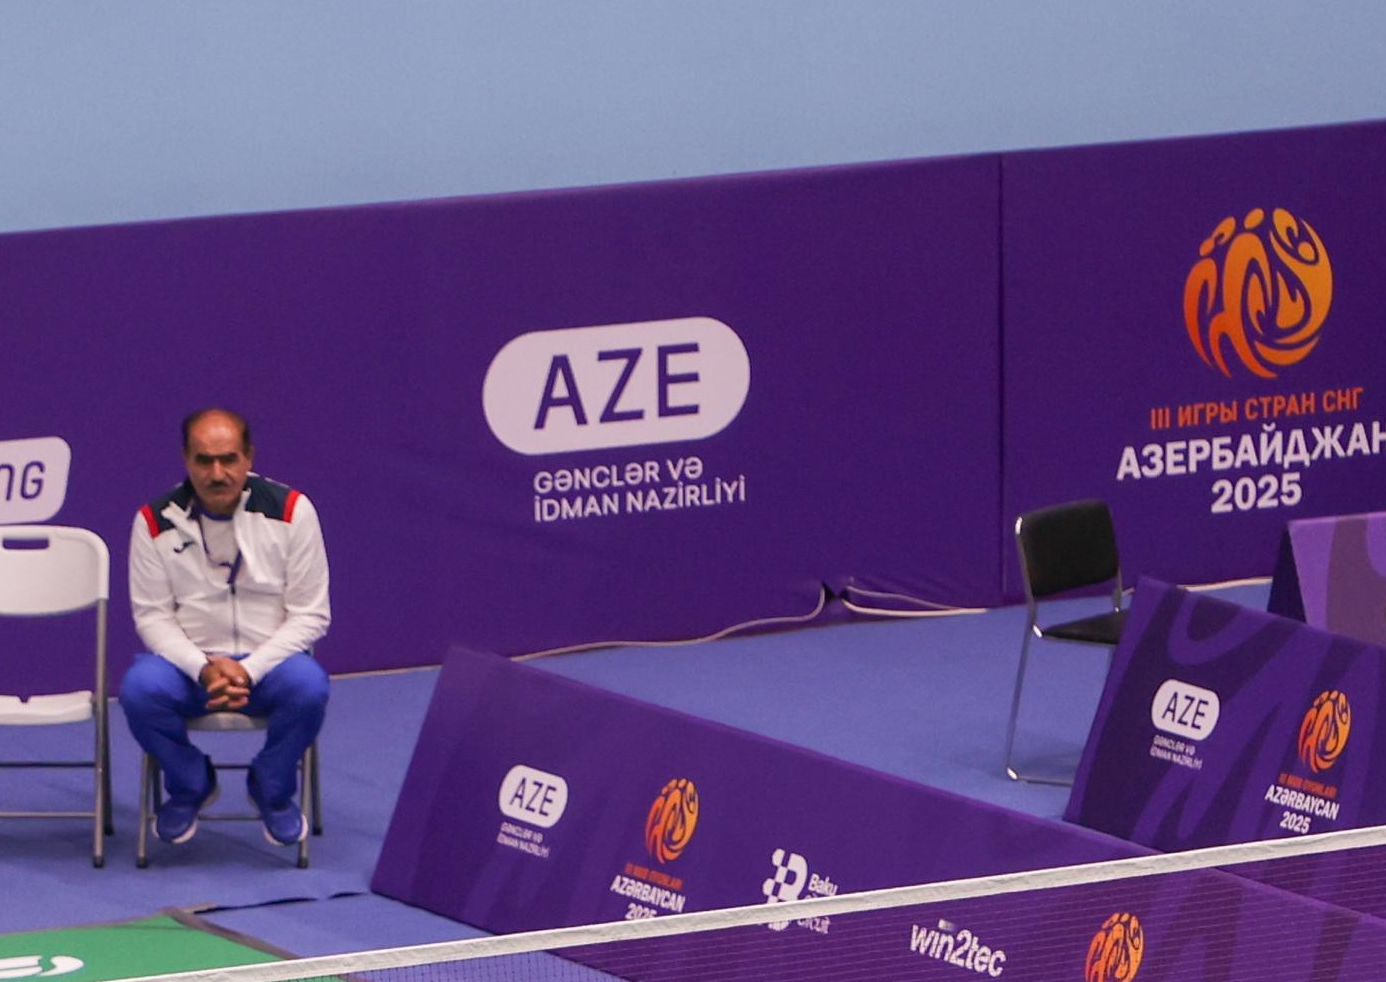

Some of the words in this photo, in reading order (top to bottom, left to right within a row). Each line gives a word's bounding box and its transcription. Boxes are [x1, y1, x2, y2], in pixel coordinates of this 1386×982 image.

[533, 342, 701, 431] AZE
[1177, 398, 1238, 427] ИГРЫ
[1244, 391, 1315, 421] СТРАН
[1322, 386, 1365, 413] СНГ
[533, 460, 661, 494] GƏNCLƏR
[666, 456, 704, 482] VƏ
[1210, 472, 1303, 514] 2025
[533, 491, 620, 523] İDMAN
[625, 474, 746, 513] NAZİRLİYİ
[1162, 691, 1210, 730] AZE
[509, 777, 557, 817] AZE
[1264, 783, 1341, 820] AZƏRBAYCAN
[1279, 810, 1312, 835] 2025
[807, 872, 839, 897] Baku
[910, 918, 1007, 978] win2tec
